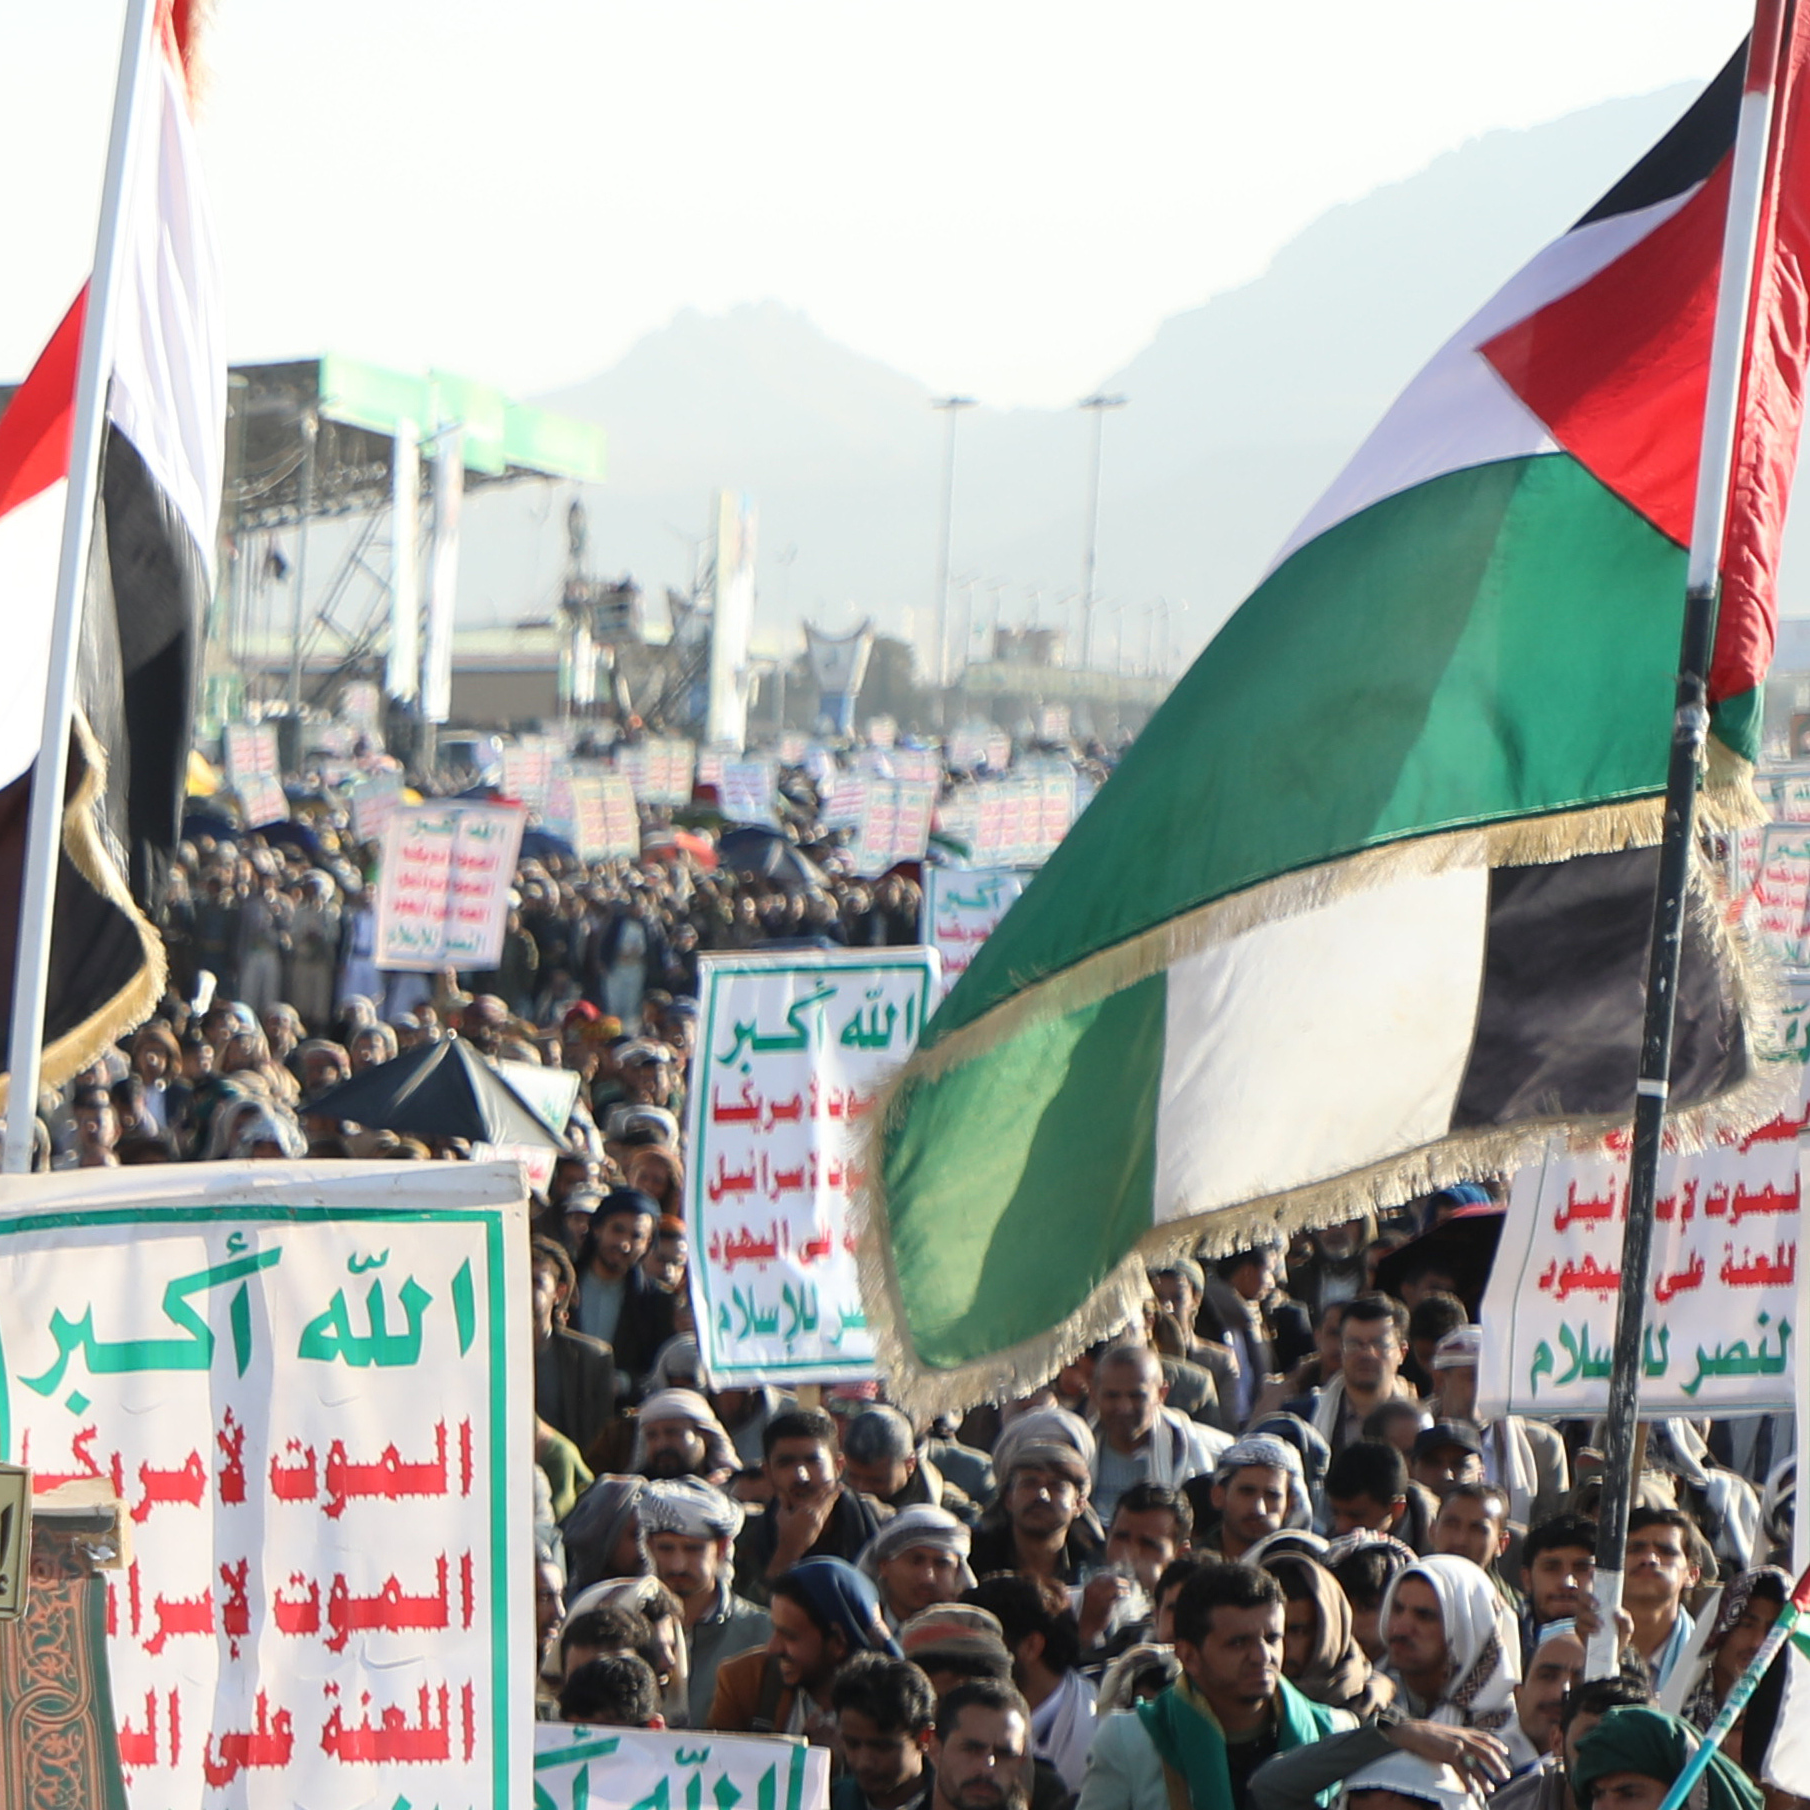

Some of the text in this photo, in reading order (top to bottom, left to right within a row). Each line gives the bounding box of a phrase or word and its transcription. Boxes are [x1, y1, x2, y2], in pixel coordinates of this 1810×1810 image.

[714, 978, 915, 1075] الله أكبر
[17, 1230, 477, 1417] الله أكبر
[716, 1278, 821, 1356] للإسلام
[269, 1412, 474, 1521] الموت
[271, 1546, 474, 1657] الموت
[202, 1688, 294, 1789] على
[319, 1678, 476, 1767] اللعنة
